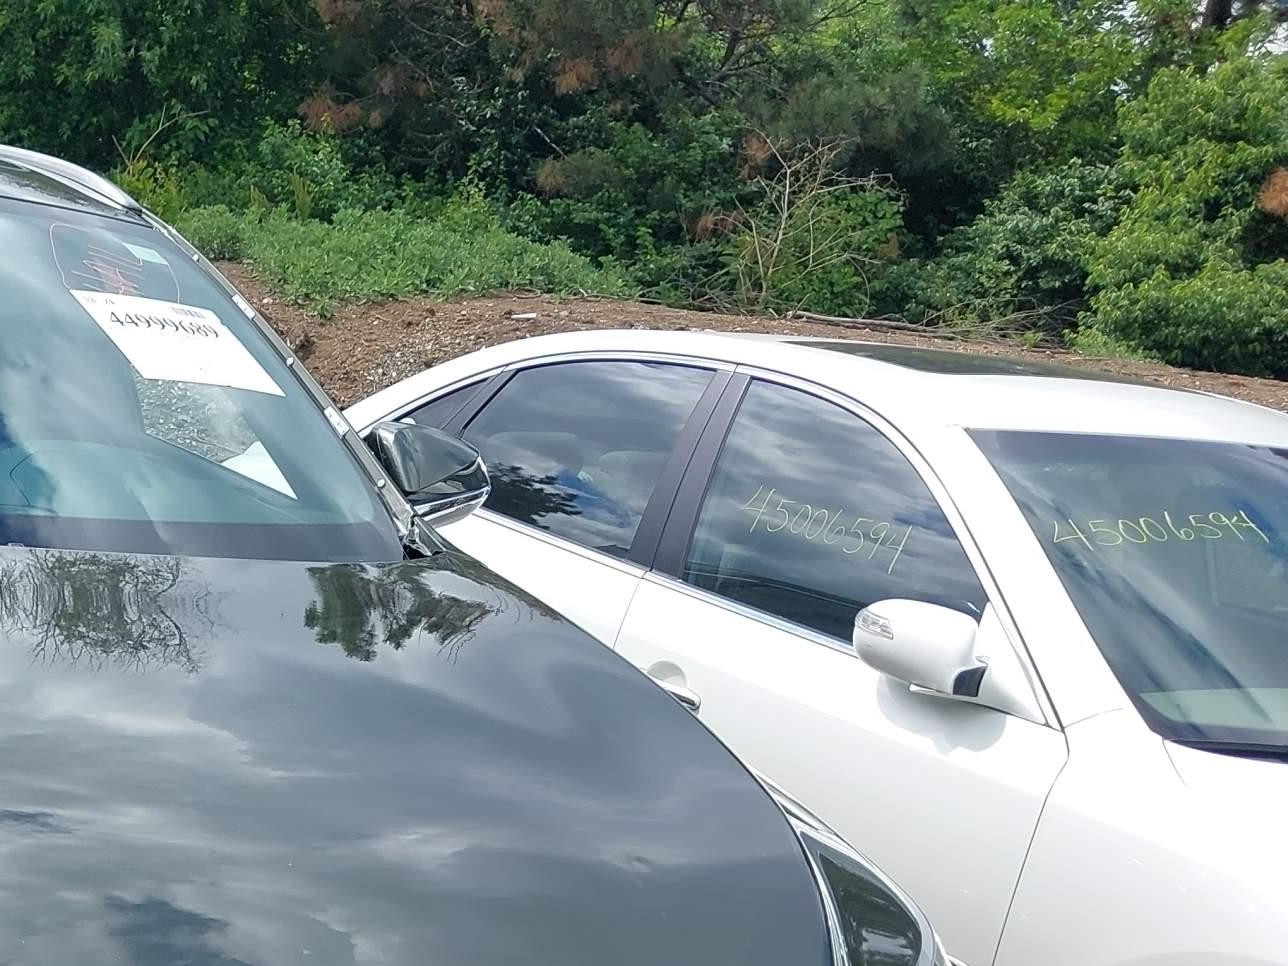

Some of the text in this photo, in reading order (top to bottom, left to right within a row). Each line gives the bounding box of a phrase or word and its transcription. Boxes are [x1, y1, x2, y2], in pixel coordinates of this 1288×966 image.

[110, 312, 219, 338] 44999689
[741, 485, 912, 574] 45006594
[1052, 510, 1270, 549] 45006594
